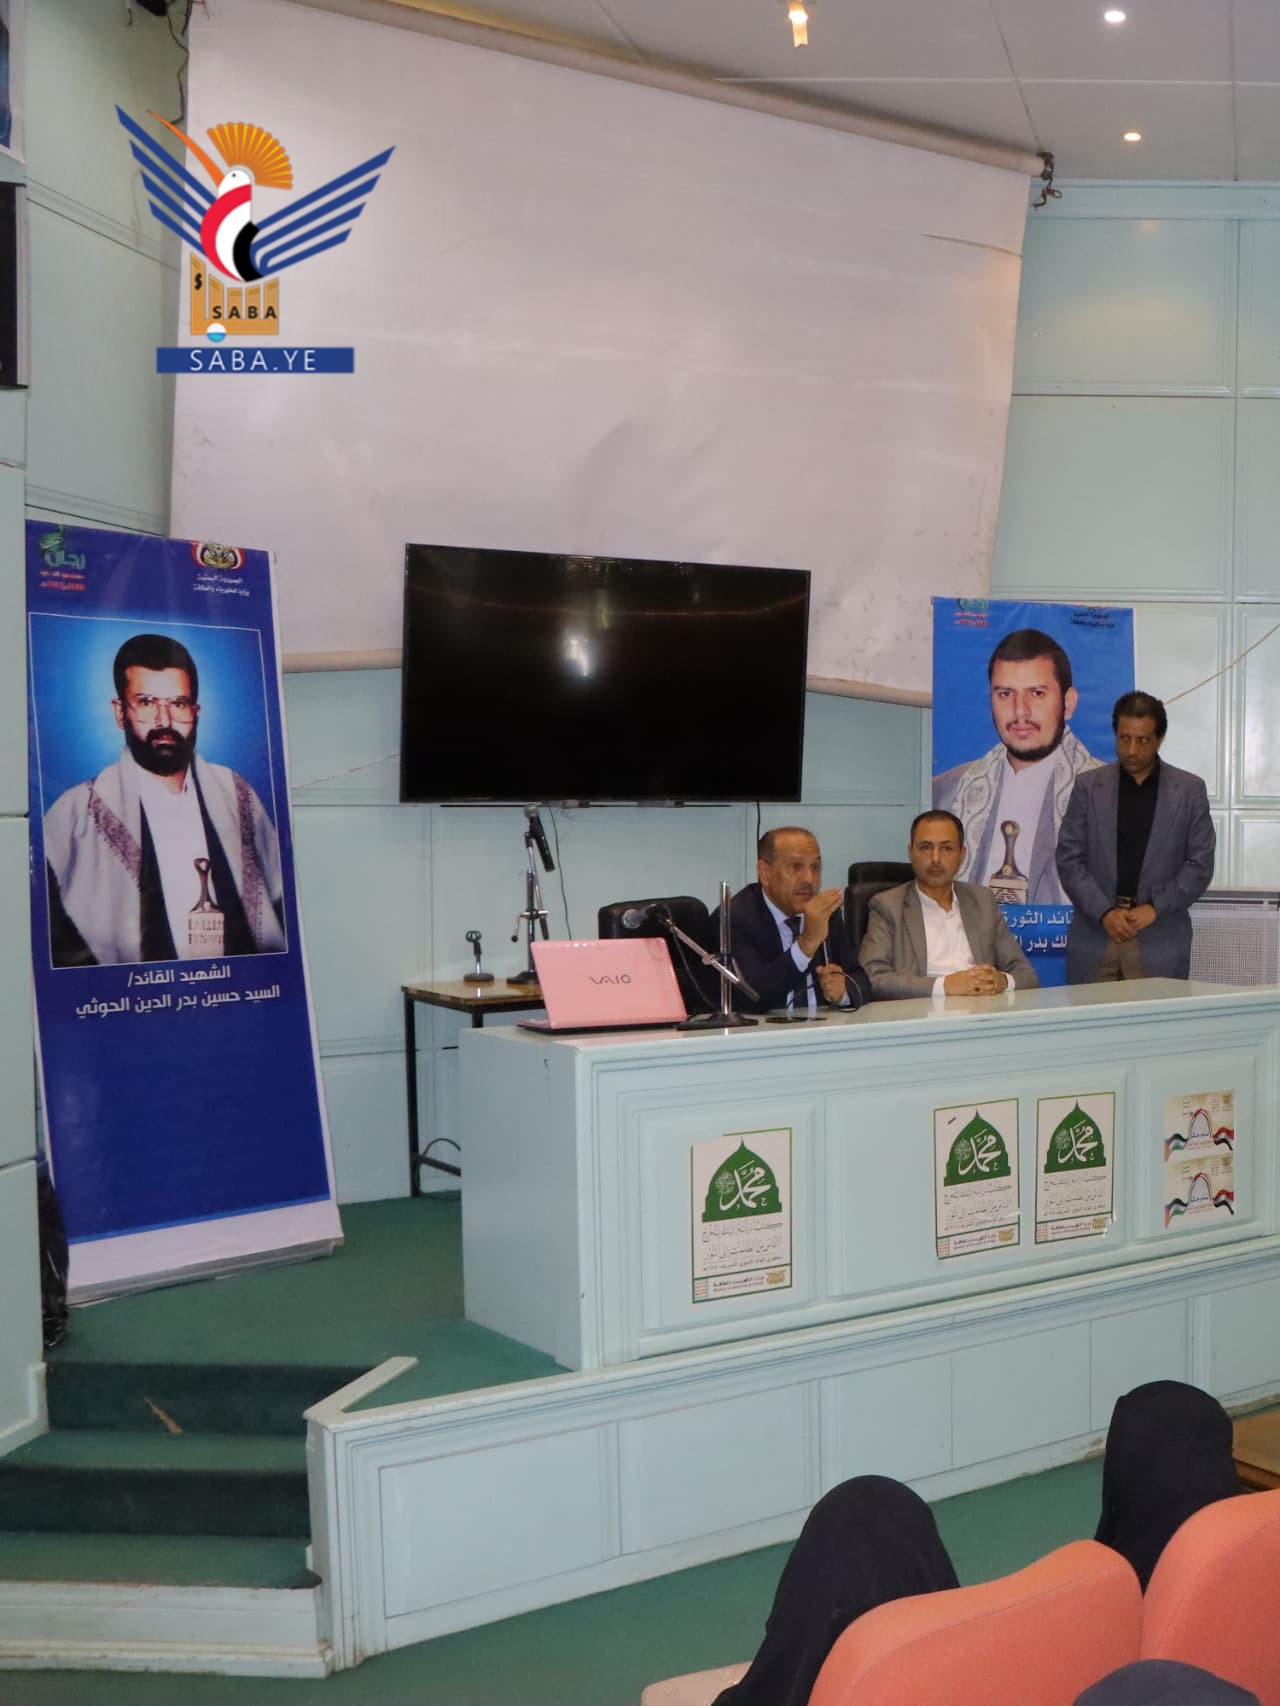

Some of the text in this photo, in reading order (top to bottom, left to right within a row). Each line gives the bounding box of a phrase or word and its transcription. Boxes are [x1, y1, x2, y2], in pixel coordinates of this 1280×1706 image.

[1048, 910, 1074, 925] ائد
[1026, 936, 1048, 952] بدر
[127, 964, 231, 988] الشهيد القائد/
[588, 974, 631, 985] VAIO
[76, 985, 281, 1018] السيد حسين بدر الدين الحوثي
